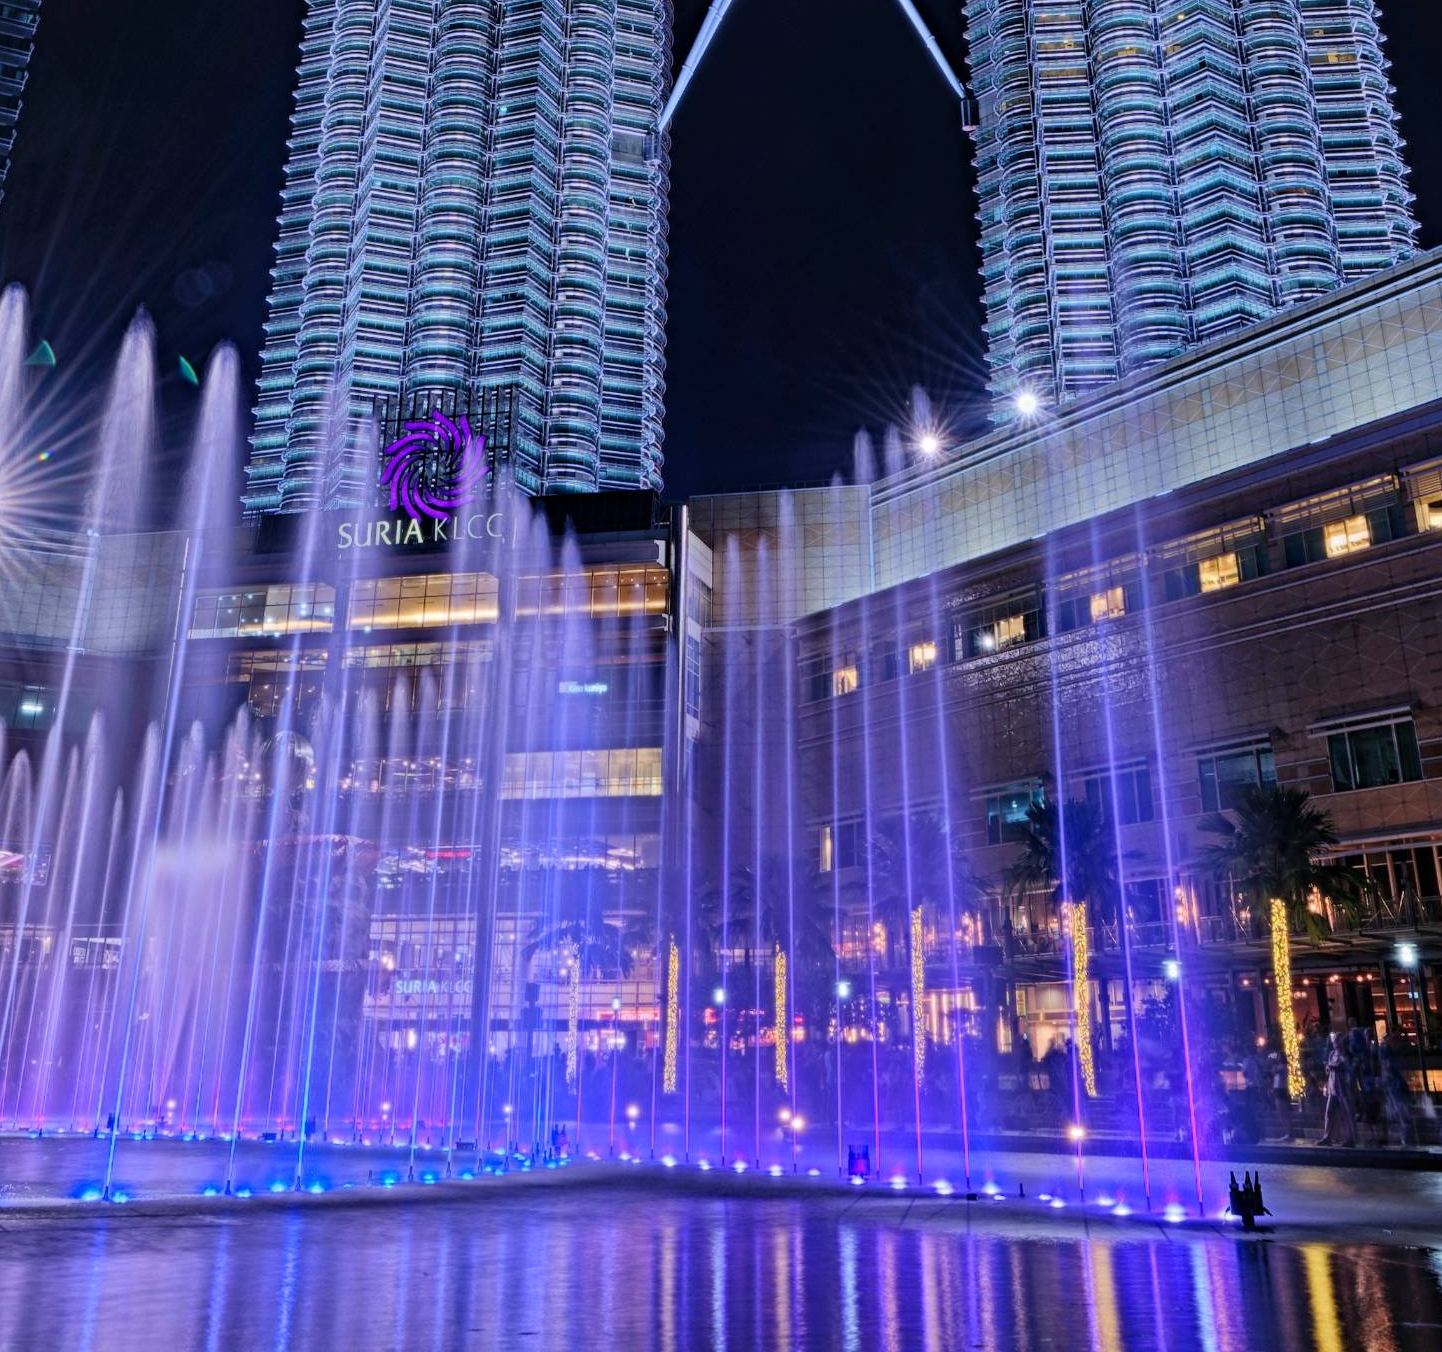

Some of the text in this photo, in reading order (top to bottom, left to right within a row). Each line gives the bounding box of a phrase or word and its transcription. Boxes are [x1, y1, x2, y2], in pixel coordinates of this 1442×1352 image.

[337, 513, 503, 549] SURIA KLCC
[395, 979, 437, 994] SURIA
